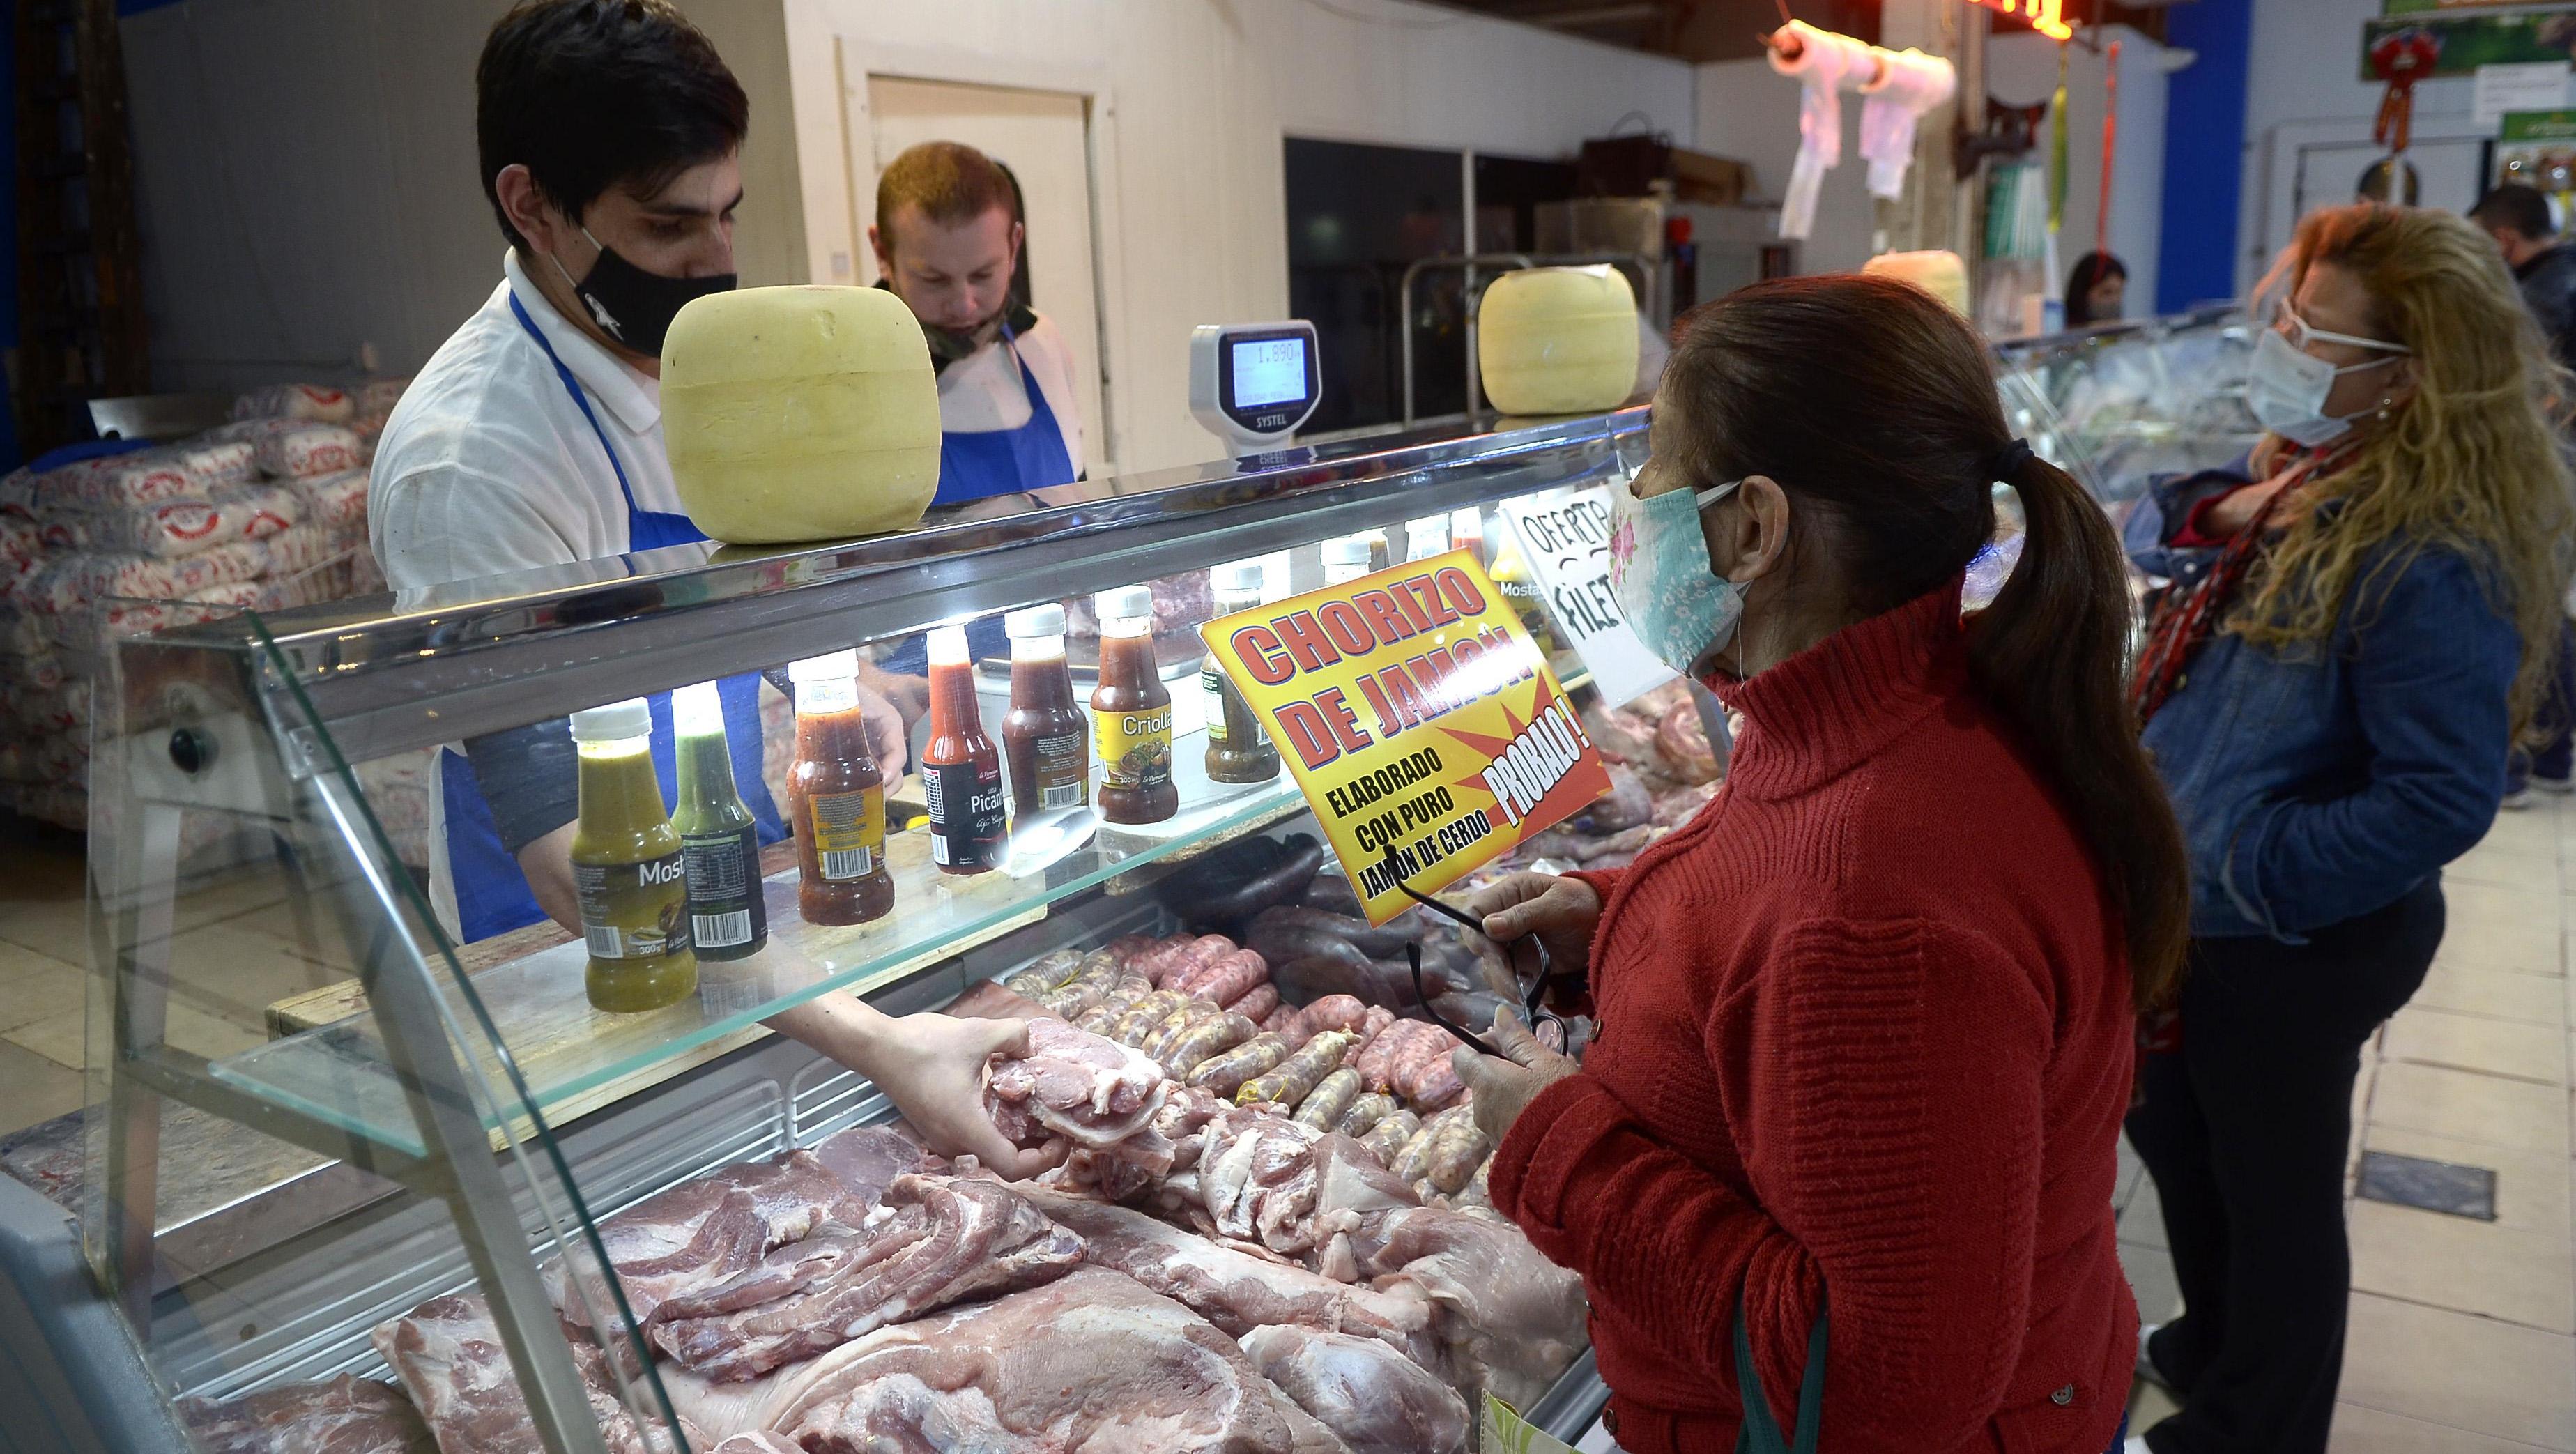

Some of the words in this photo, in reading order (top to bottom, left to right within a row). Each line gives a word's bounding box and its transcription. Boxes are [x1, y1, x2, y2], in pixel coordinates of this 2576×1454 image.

[1256, 413, 1287, 429] SYSTEL
[1229, 566, 1488, 687] CHORIZO
[1122, 712, 1172, 735] Criolla
[1272, 686, 1374, 772] DE
[1325, 746, 1443, 819] ELABORADO
[1354, 810, 1404, 853] CON
[1397, 785, 1455, 832] PURO
[639, 855, 685, 887] Most
[1358, 845, 1423, 901] JAMON
[1413, 834, 1444, 869] DE
[1436, 808, 1492, 857] CERDO
